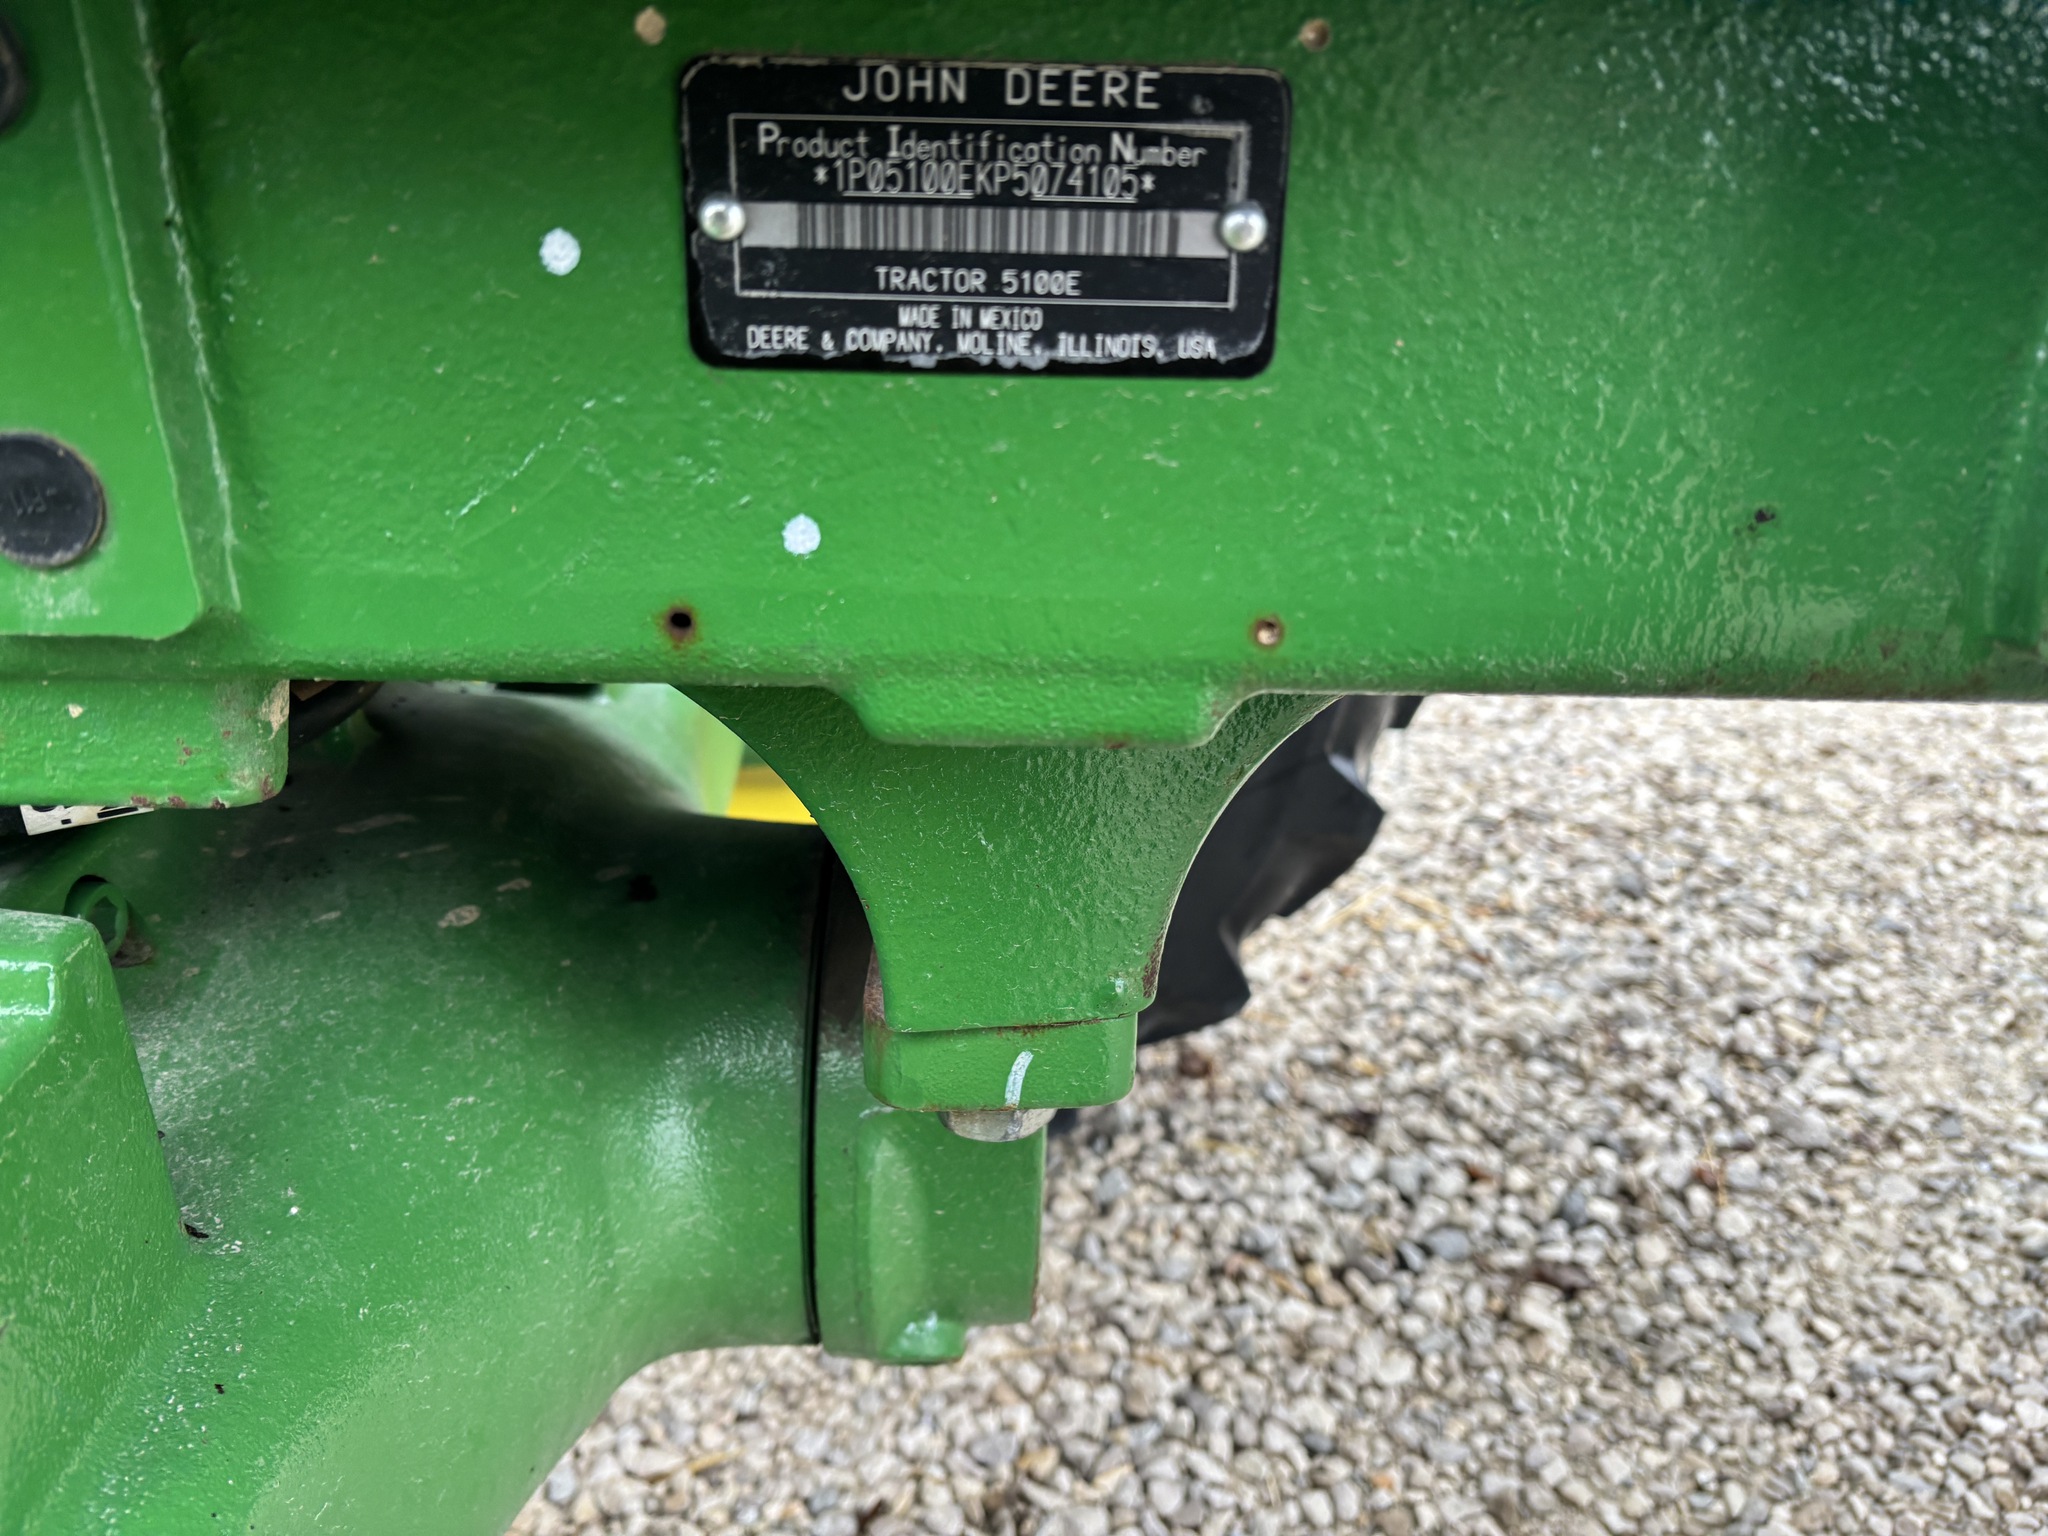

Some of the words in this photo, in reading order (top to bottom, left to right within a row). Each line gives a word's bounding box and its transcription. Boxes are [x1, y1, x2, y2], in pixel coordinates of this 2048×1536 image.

[842, 64, 967, 103] JOHN
[1005, 67, 1161, 110] DEERE
[758, 121, 870, 158] Product
[887, 124, 1101, 164] Identification
[1110, 130, 1207, 167] Number
[875, 266, 987, 293] TRACTOR
[1002, 268, 1082, 296] 5100E
[898, 304, 941, 329] MADE
[952, 305, 974, 330] IN
[979, 306, 1044, 331] MEXICO
[746, 324, 810, 350] DEERE
[821, 330, 835, 350] &
[1177, 333, 1218, 360] USA
